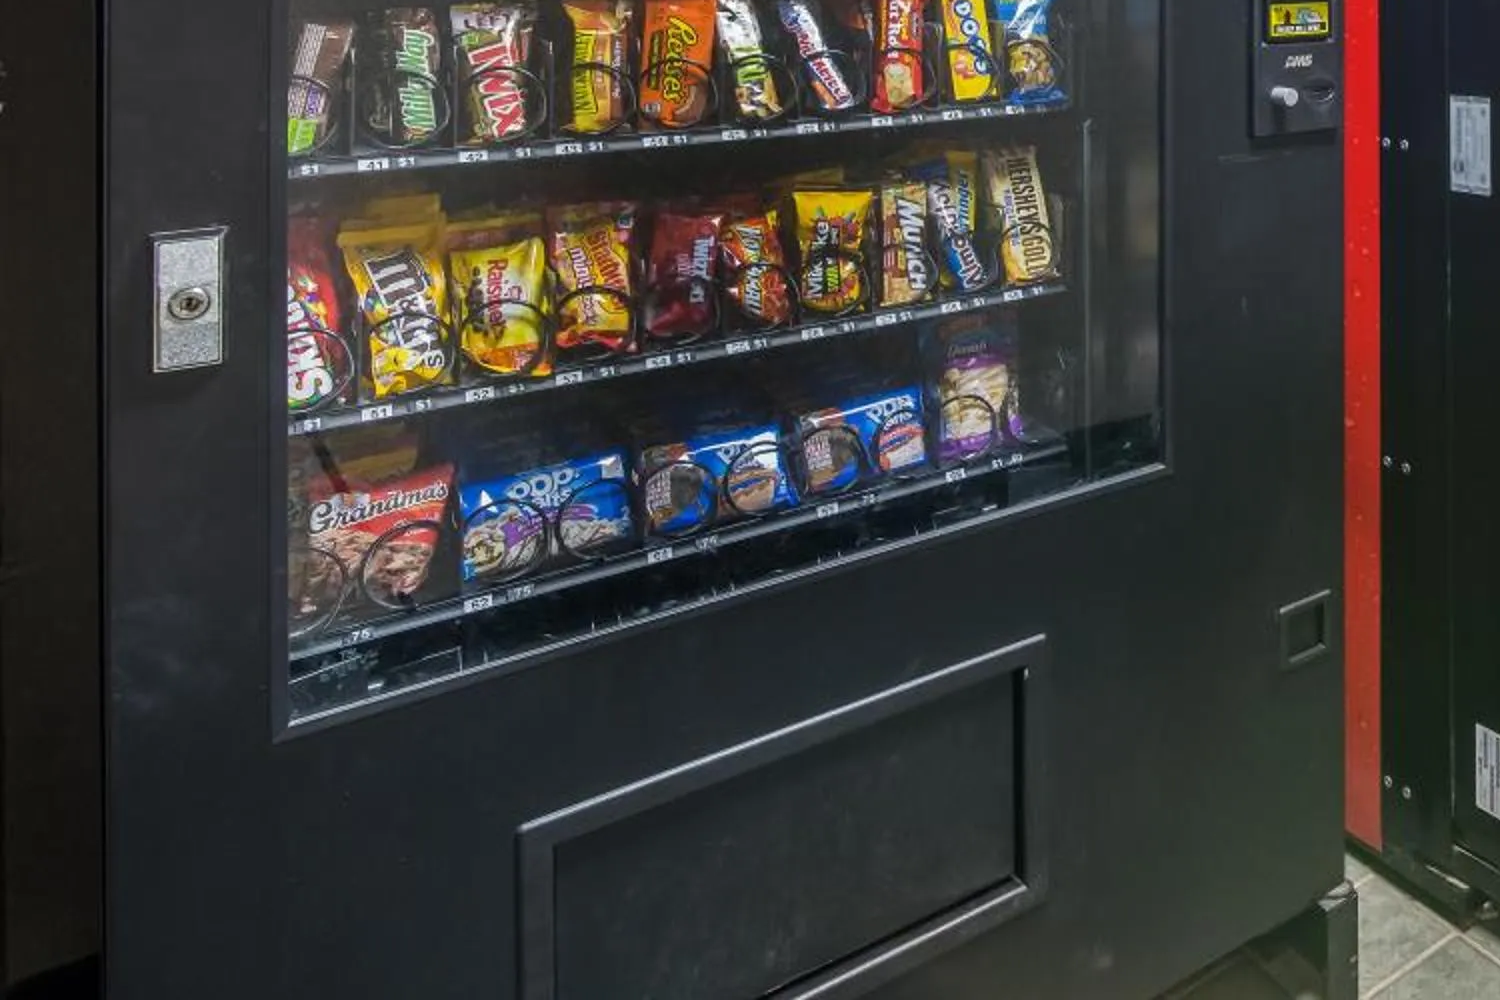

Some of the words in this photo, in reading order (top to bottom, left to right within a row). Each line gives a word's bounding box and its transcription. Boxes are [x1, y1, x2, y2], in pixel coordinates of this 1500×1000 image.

[663, 15, 697, 104] Reese's
[953, 0, 994, 75] DOTS
[897, 198, 927, 292] MUNCH
[415, 399, 431, 412] $1
[309, 482, 449, 536] Grandma's
